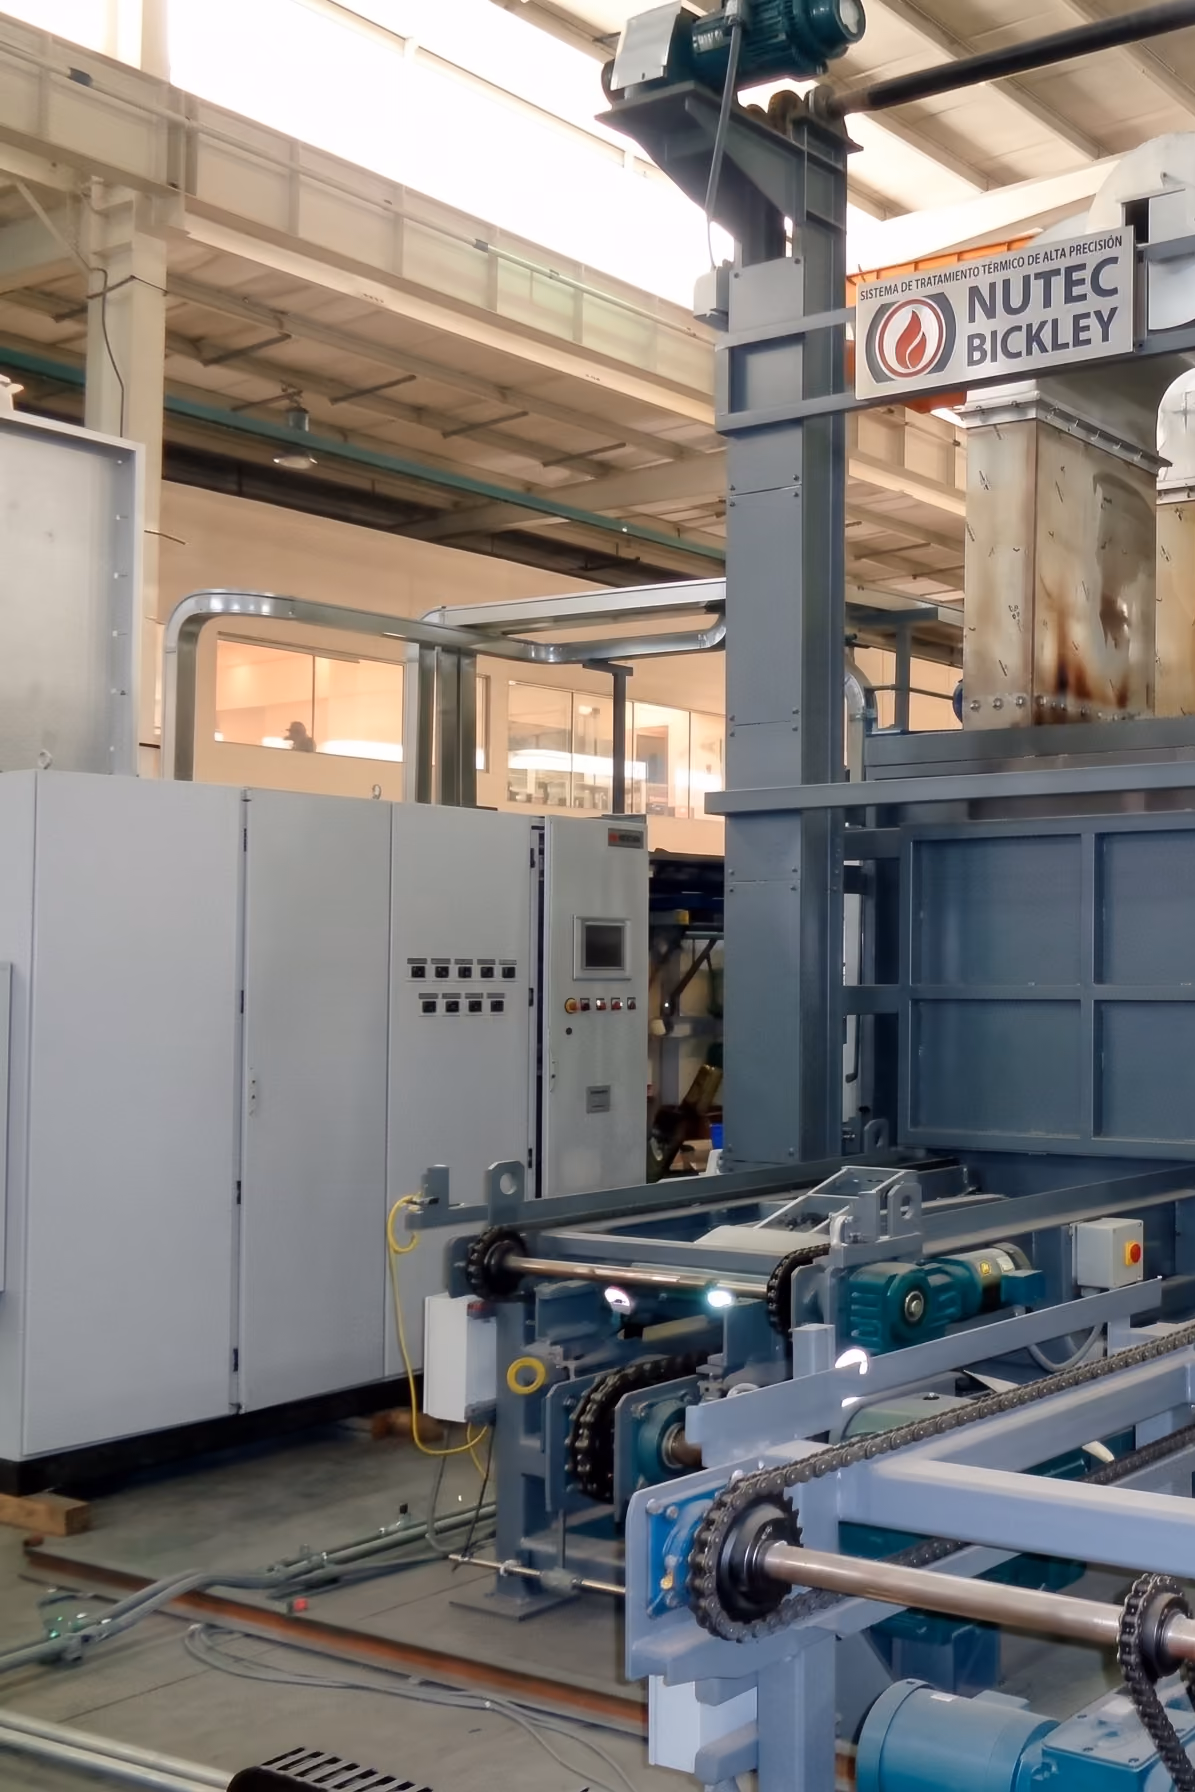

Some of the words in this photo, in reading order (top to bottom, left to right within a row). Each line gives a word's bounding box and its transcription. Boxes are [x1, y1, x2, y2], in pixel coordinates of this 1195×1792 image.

[860, 283, 899, 301] SISTEMA
[901, 280, 913, 293] DE
[915, 266, 980, 290] TRATAMIENTO
[981, 256, 1025, 275] TÉRMICO
[1027, 253, 1041, 265] DE
[1042, 247, 1067, 263] ALTA
[1069, 235, 1122, 257] PRECISIÓN
[968, 256, 1119, 324] NUTEC
[967, 306, 1119, 367] BICKLEY
